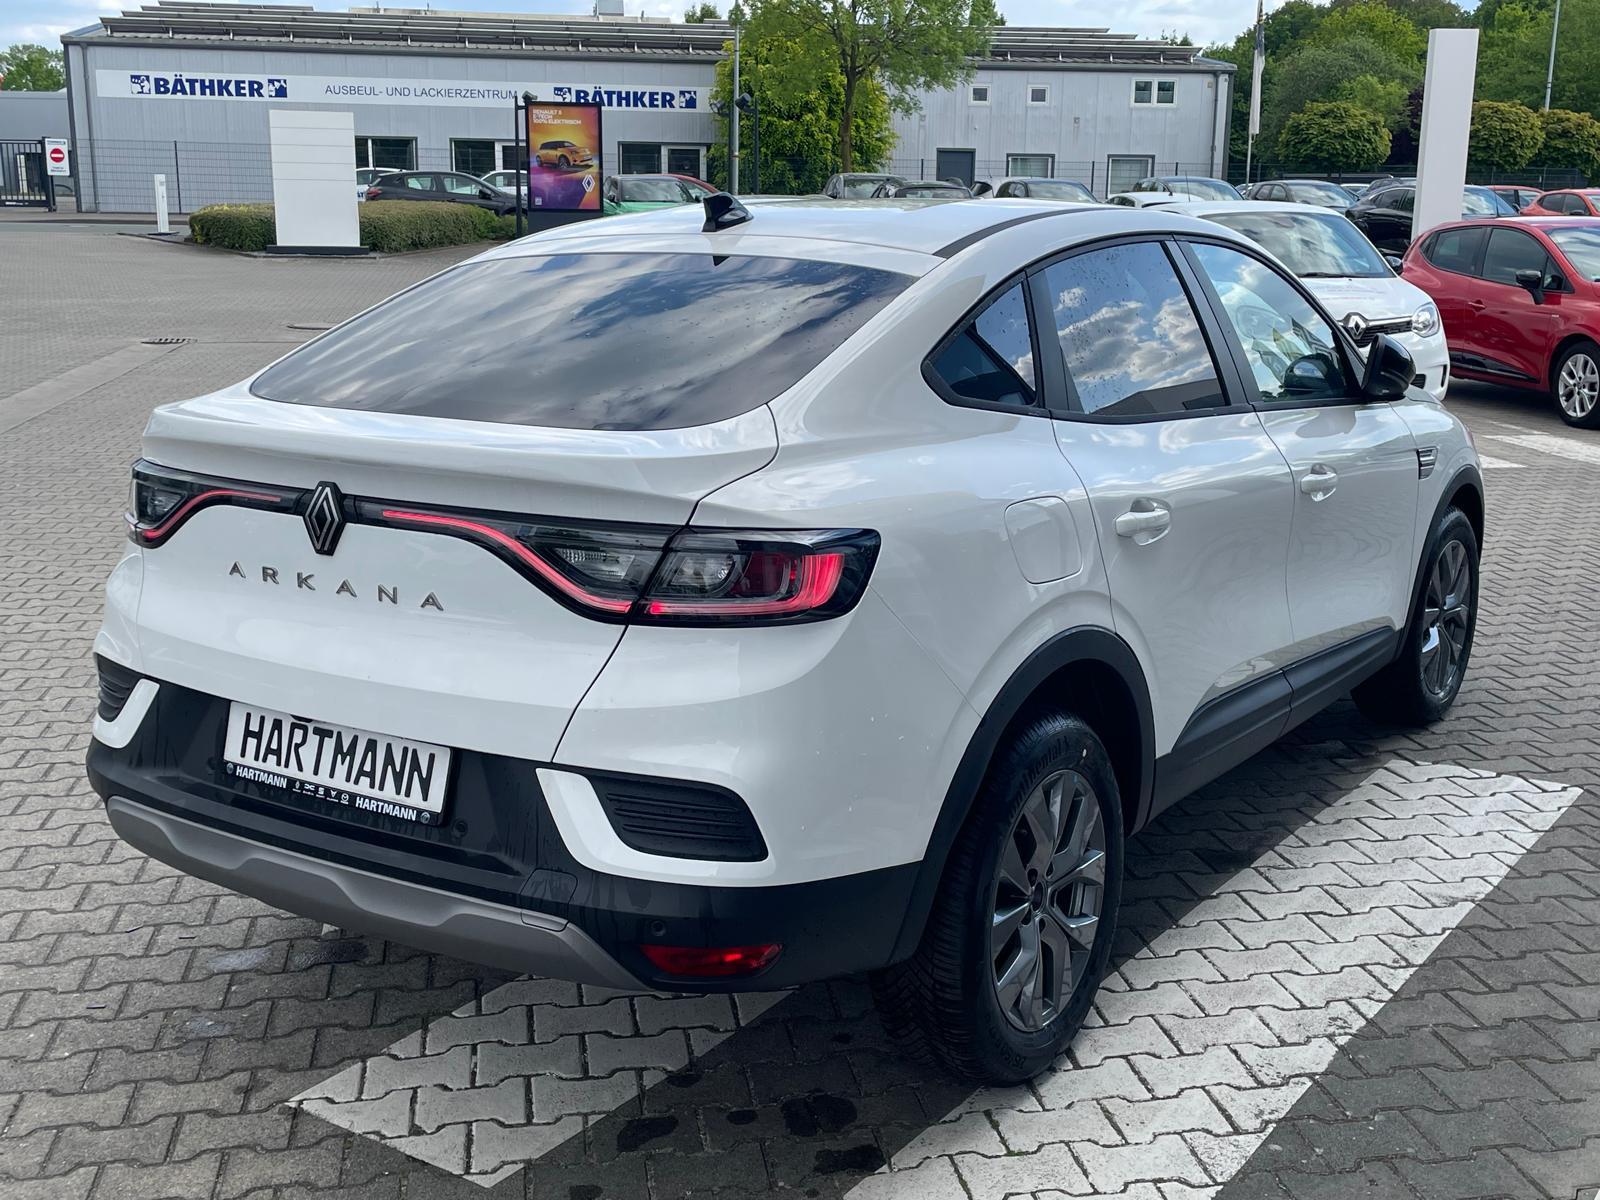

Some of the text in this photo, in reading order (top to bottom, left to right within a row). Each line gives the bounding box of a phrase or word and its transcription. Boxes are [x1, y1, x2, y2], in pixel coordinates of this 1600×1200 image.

[154, 74, 265, 98] BÄTHKER
[325, 85, 517, 100] AUSBEUL- UND LACKIERZENTRUM
[575, 86, 676, 109] BÄTHKER
[229, 560, 444, 611] ARKANA
[240, 711, 436, 802] HARTMANN
[235, 765, 288, 788] HARTMANN
[355, 796, 417, 821] HARTMANN
